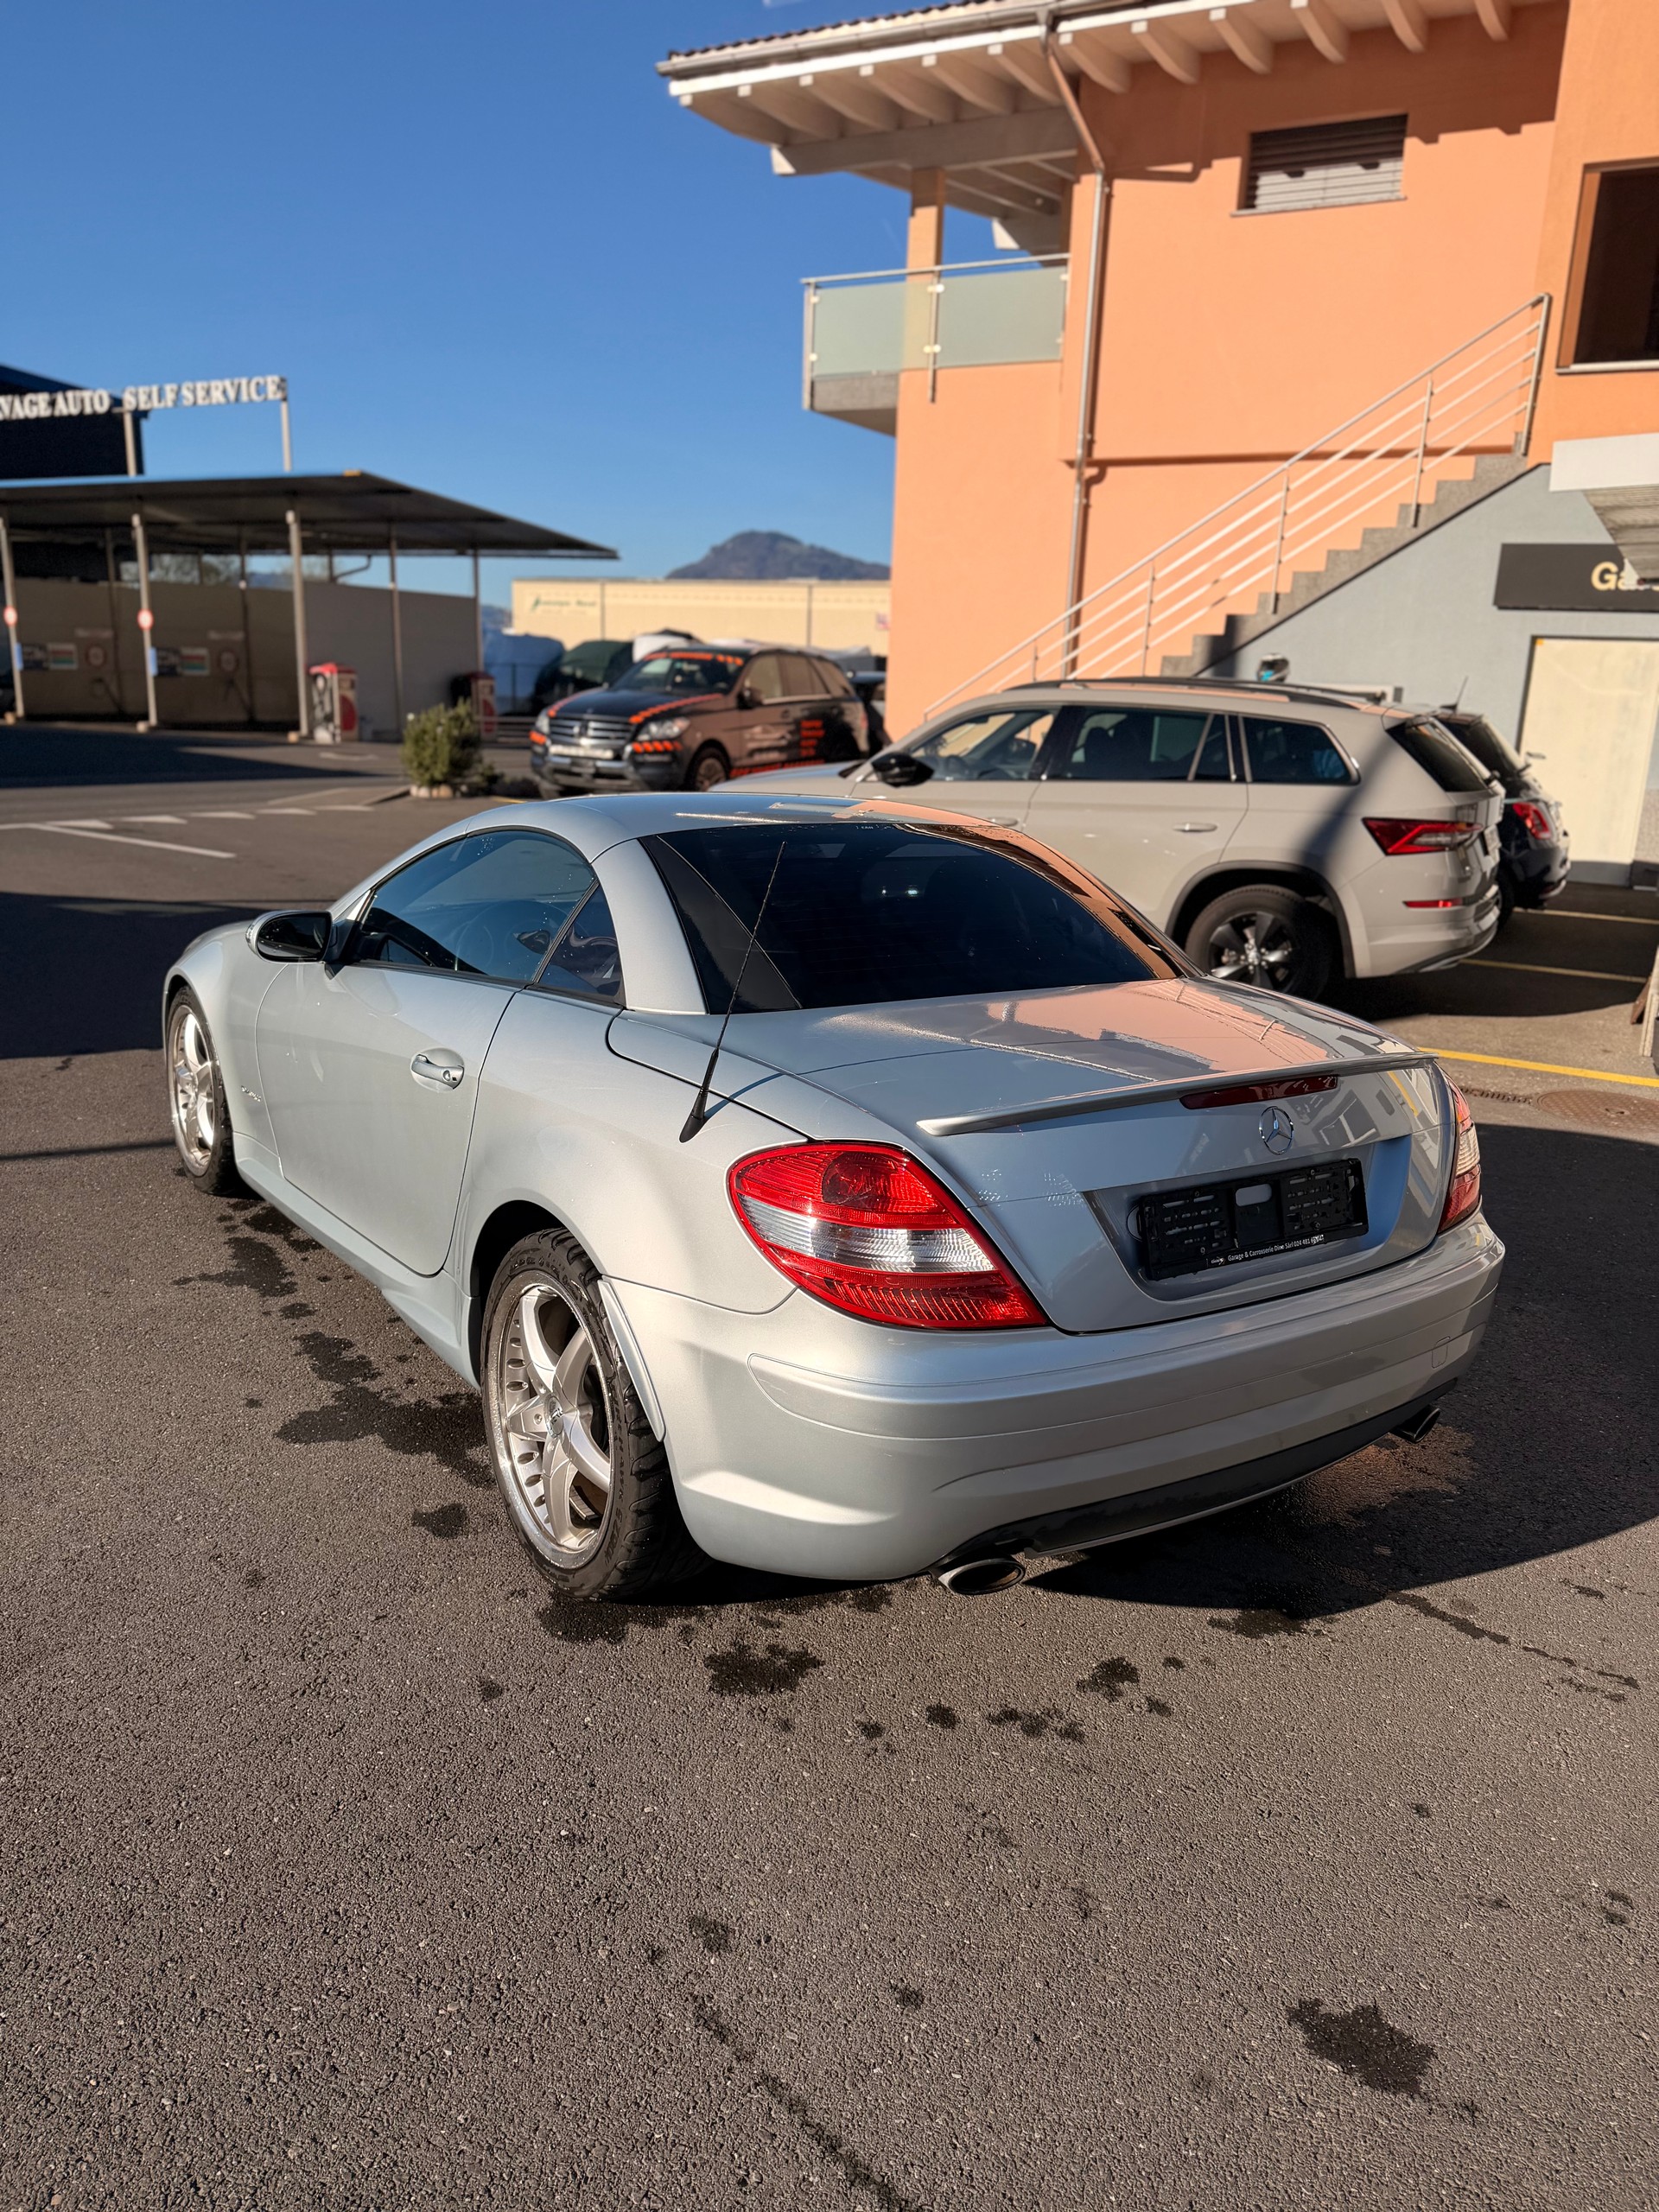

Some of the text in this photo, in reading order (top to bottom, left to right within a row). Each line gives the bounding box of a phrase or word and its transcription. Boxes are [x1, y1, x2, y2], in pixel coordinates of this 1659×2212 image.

[0, 375, 283, 422] VAGE AUTO SELF SERVICE
[1228, 1252, 1244, 1262] Garage
[1249, 1246, 1274, 1258] Carrosserie
